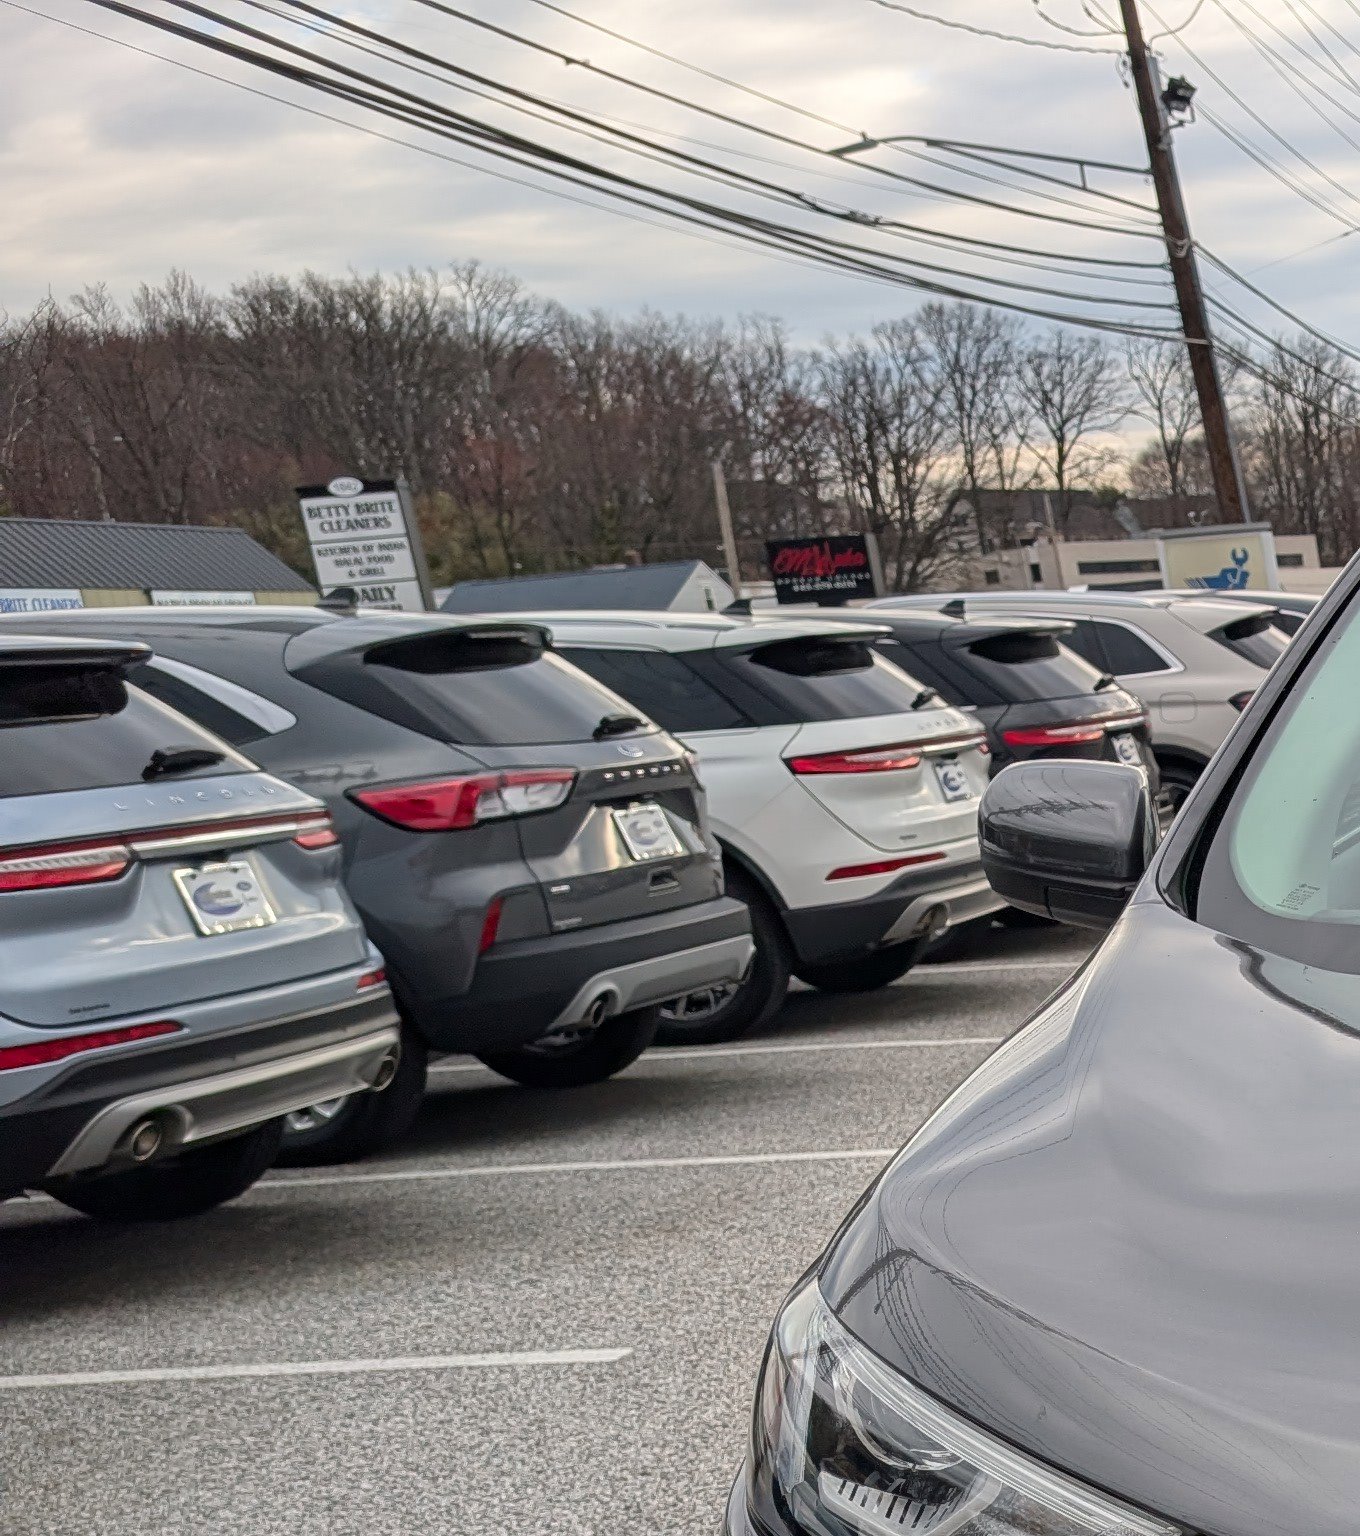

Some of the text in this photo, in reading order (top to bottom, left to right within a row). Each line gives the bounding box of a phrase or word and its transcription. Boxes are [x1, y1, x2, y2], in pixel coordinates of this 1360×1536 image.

[306, 501, 396, 518] BETTY BRITE
[319, 515, 392, 534] CLEANERS
